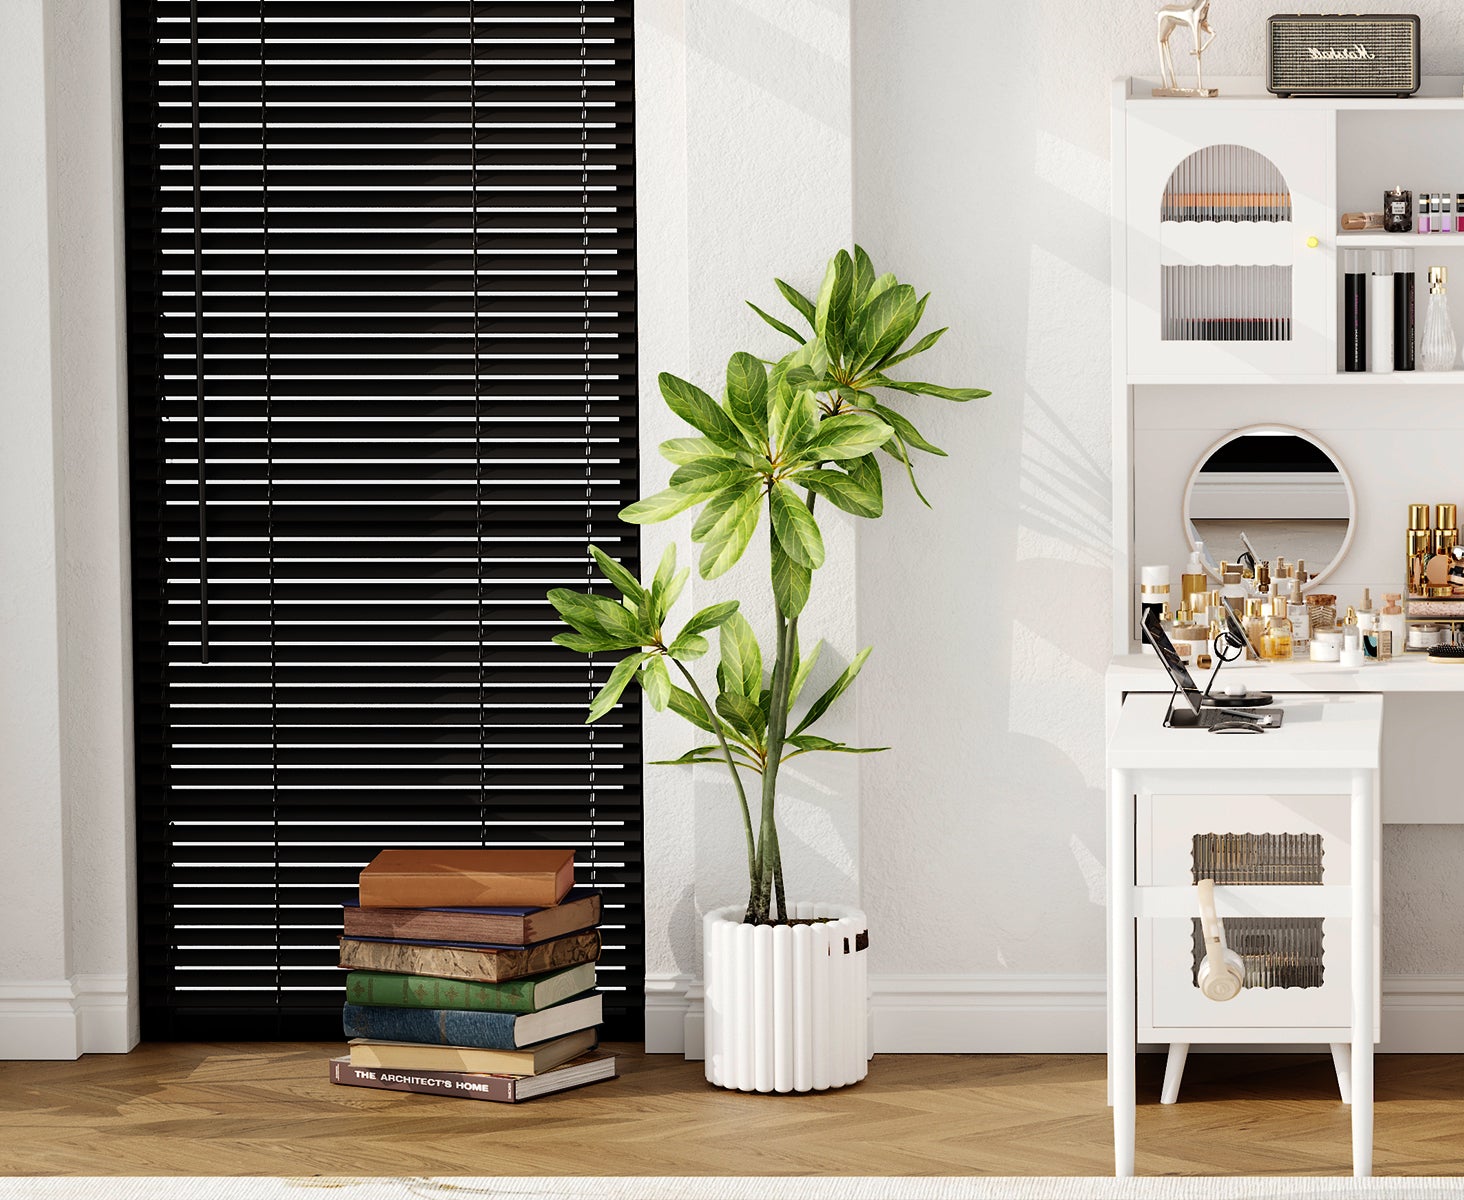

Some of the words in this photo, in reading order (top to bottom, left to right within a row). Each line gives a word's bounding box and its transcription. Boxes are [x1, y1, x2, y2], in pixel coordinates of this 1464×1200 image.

[354, 1070, 376, 1080] THE
[380, 1075, 452, 1088] ARCHITECT'S
[457, 1081, 489, 1092] HOME
